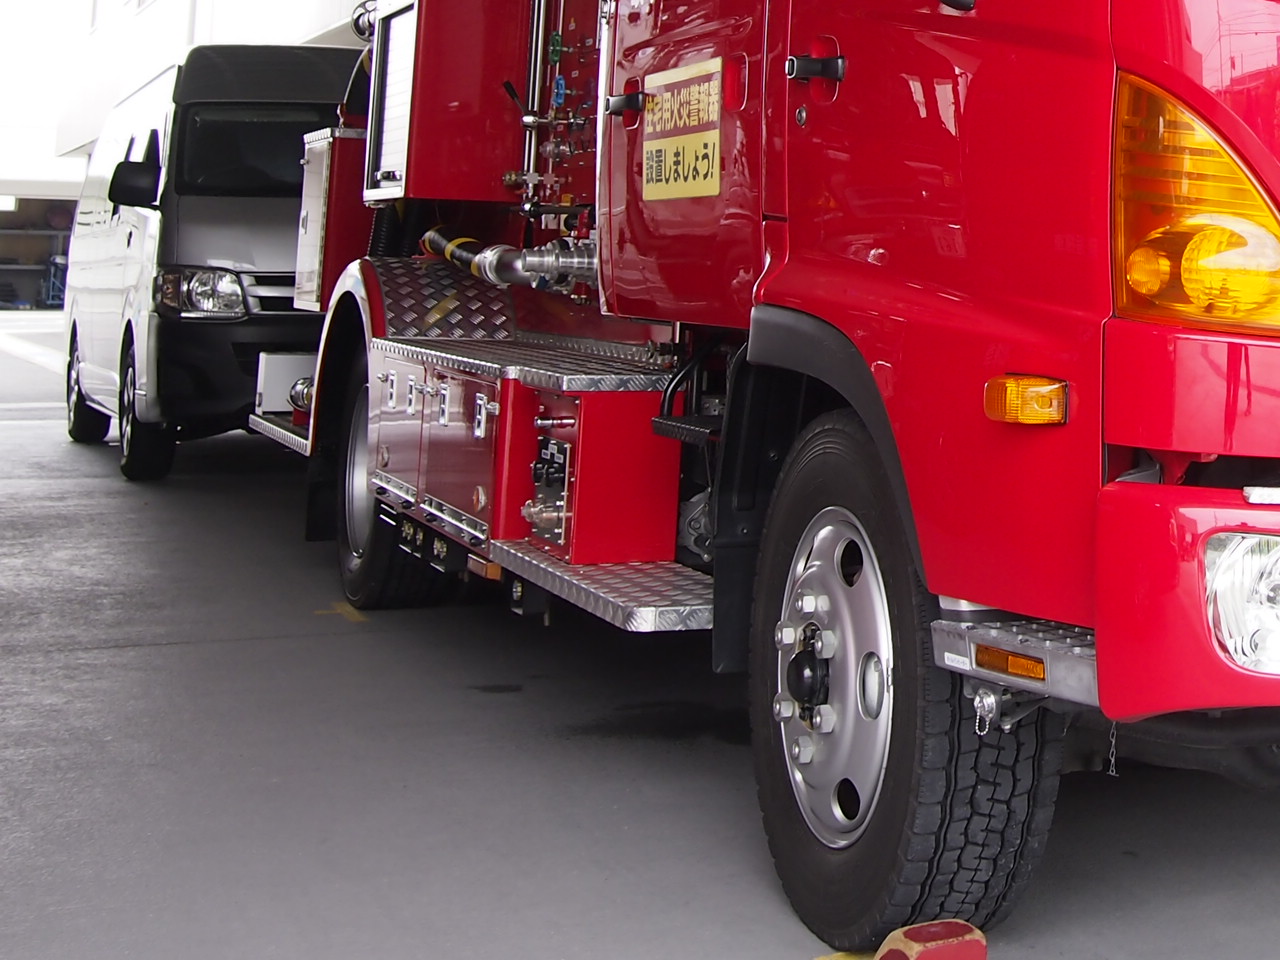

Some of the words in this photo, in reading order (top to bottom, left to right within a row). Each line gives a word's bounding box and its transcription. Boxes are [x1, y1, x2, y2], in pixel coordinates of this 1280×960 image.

[645, 142, 716, 186] 設置しましょう!
